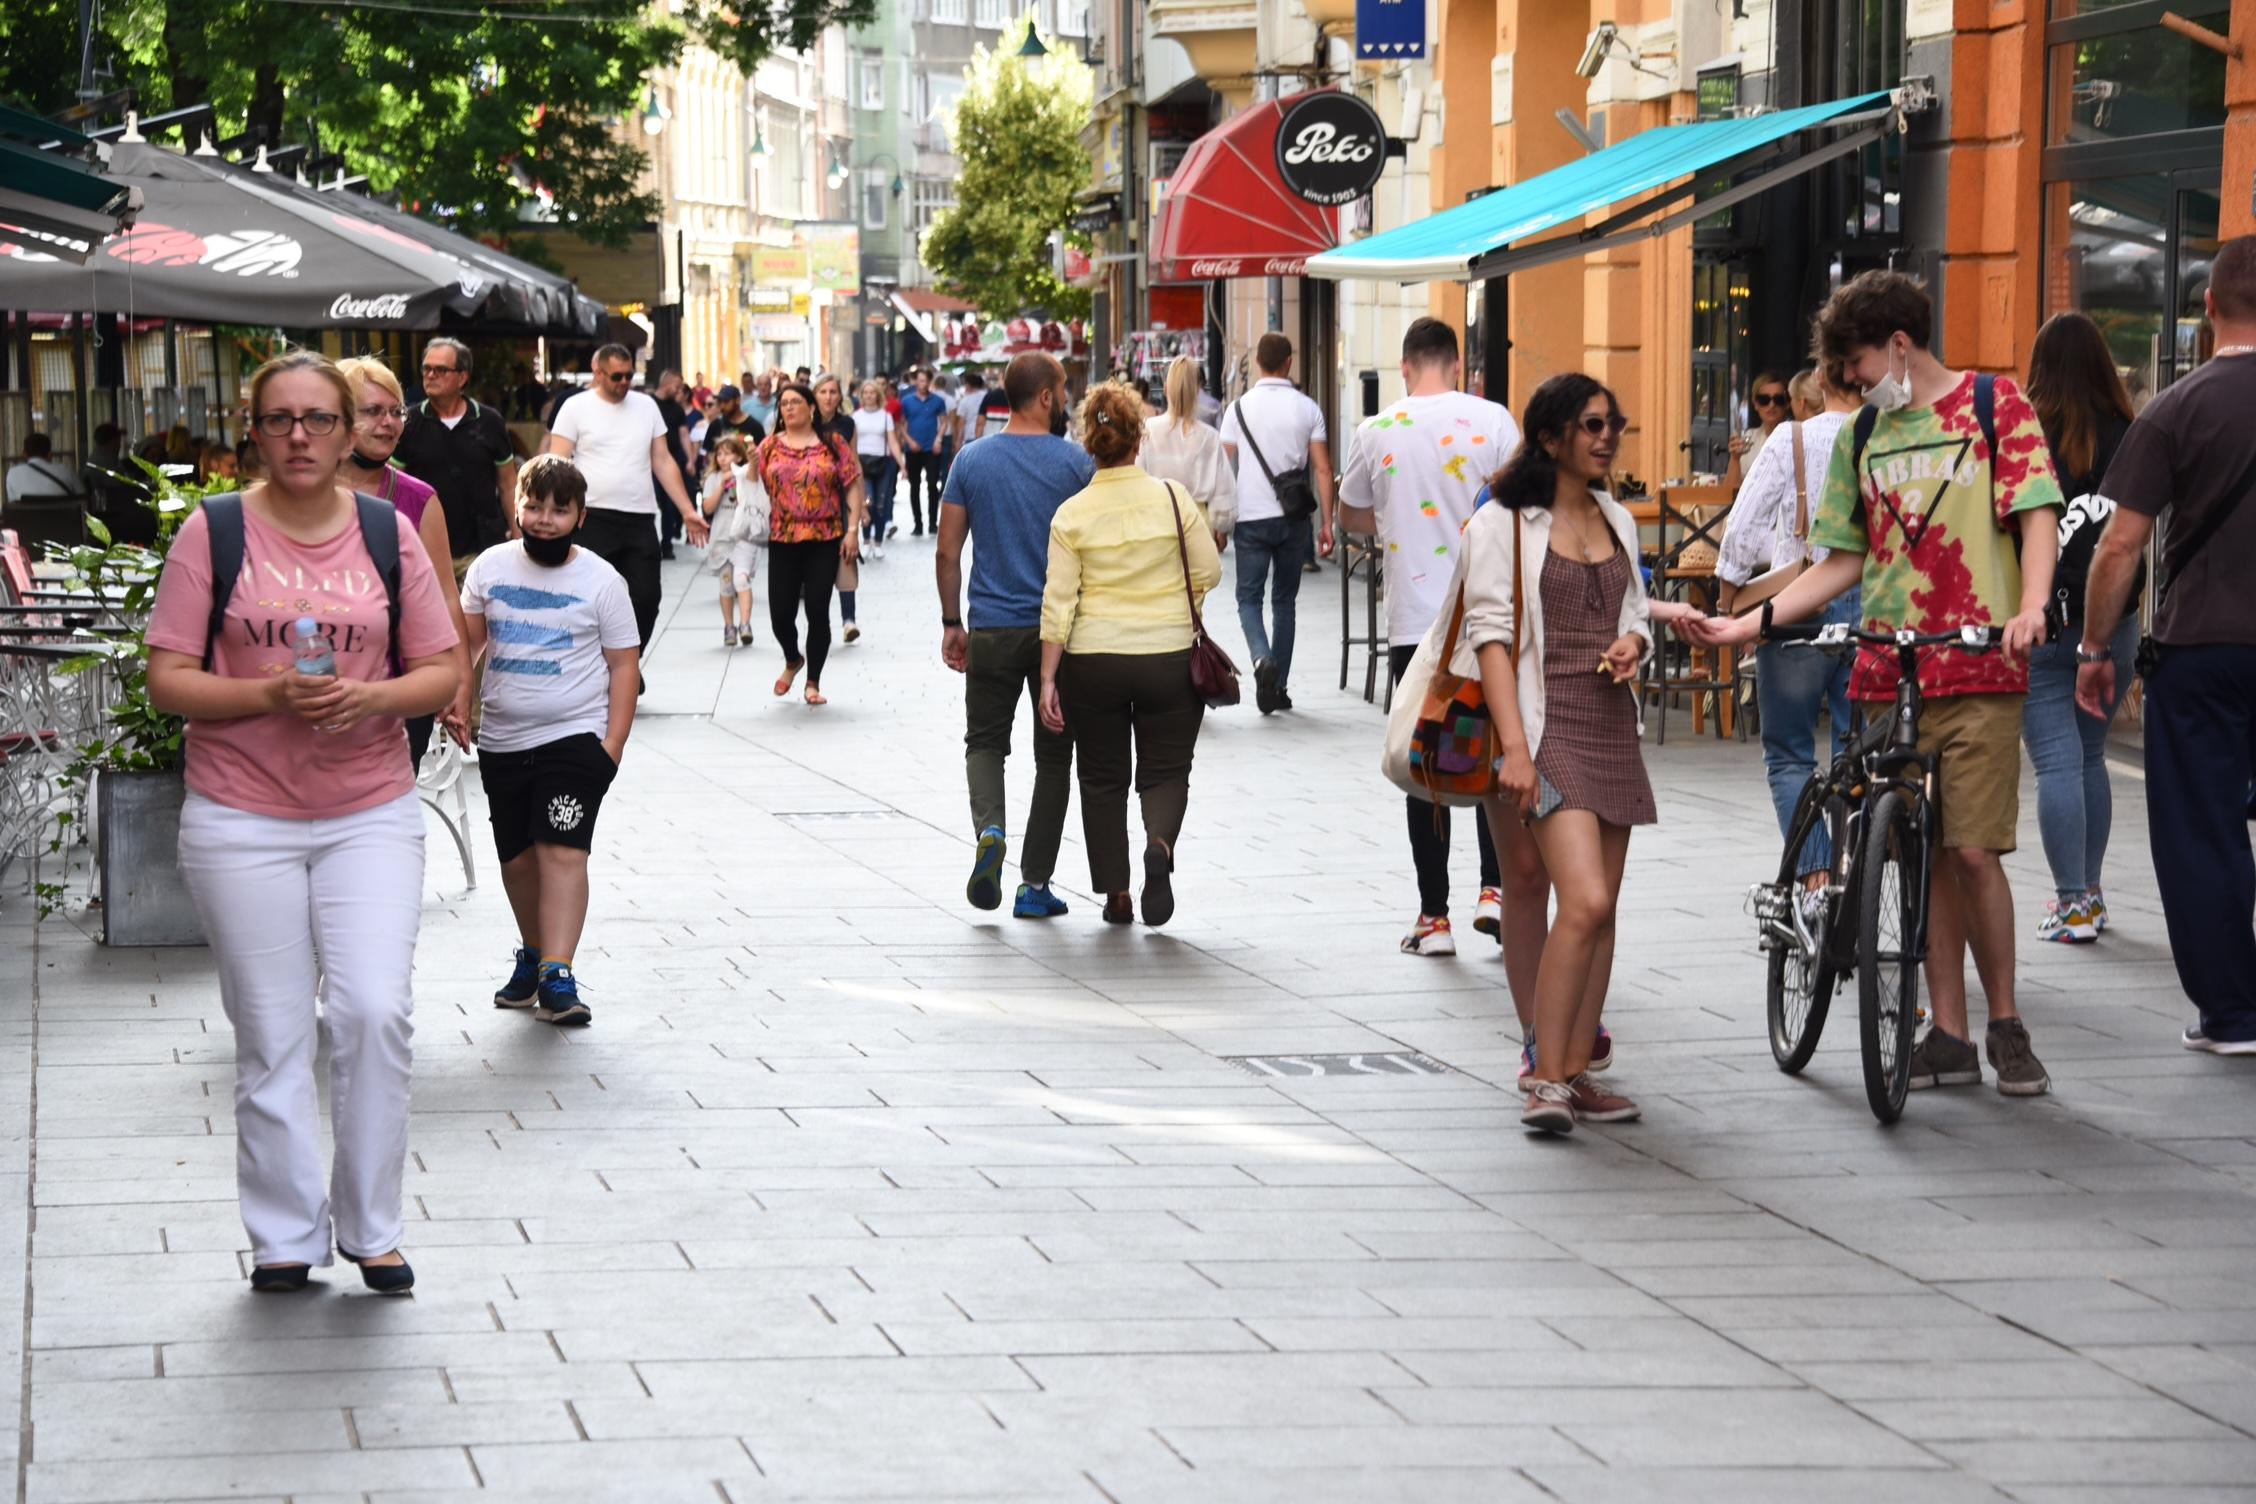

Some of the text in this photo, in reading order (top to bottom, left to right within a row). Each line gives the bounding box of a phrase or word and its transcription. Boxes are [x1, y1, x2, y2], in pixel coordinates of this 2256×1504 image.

[1285, 121, 1373, 165] Peko
[1303, 188, 1330, 204] since
[555, 804, 574, 824] 38
